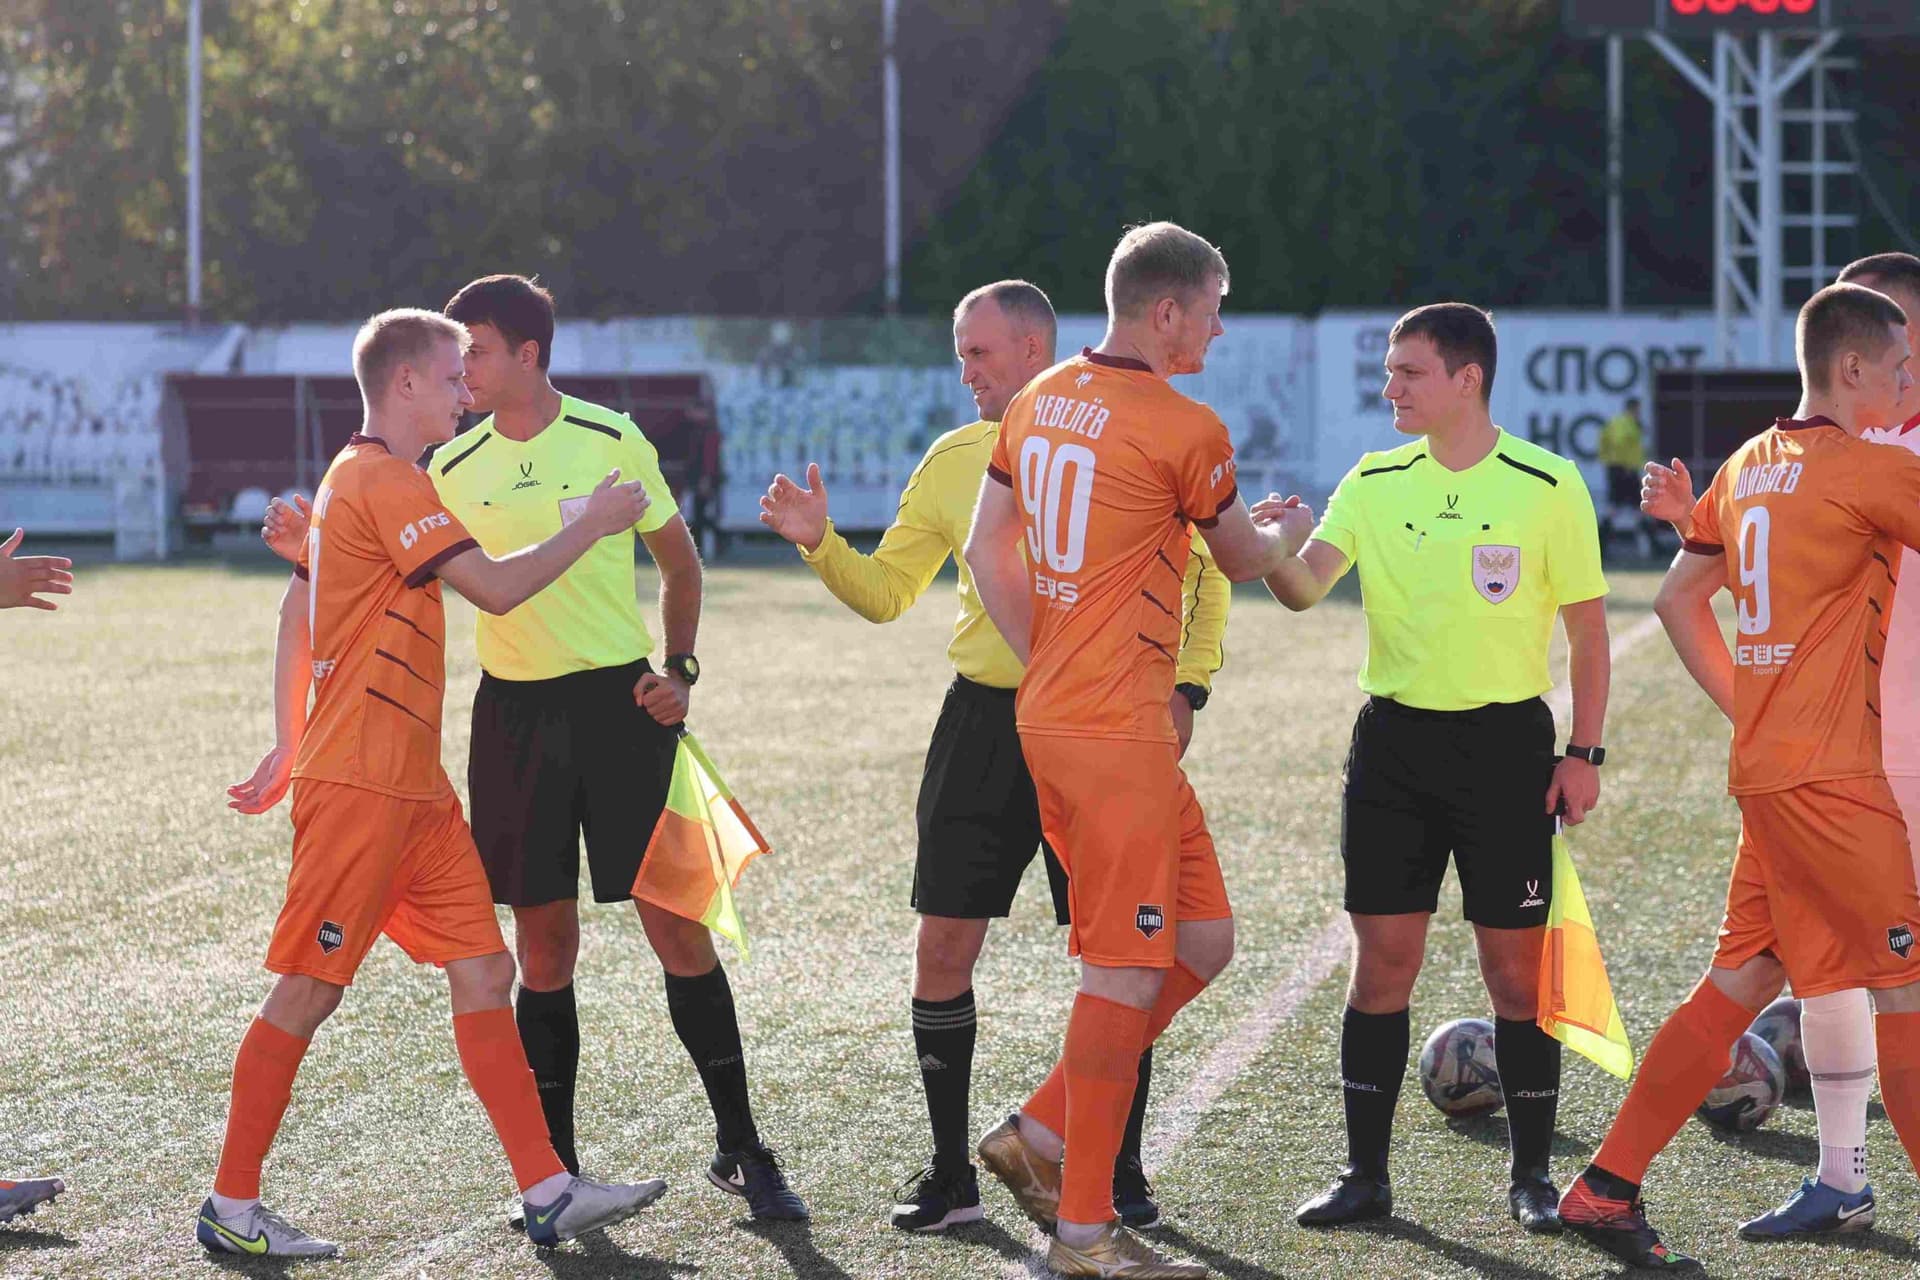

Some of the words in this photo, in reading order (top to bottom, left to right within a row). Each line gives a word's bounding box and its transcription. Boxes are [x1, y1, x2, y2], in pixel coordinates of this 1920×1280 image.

[1034, 395, 1111, 440] ЧЕВЕЛЁВ
[511, 480, 542, 491] JÖGEL
[1734, 462, 1803, 500] ШИБАЕВ
[1020, 436, 1096, 573] 90
[1435, 511, 1463, 520] JÖGEL
[418, 512, 450, 534] ПСБ
[1738, 506, 1770, 635] 9
[1737, 644, 1796, 666] EUS
[1138, 914, 1162, 927] ТЕМП
